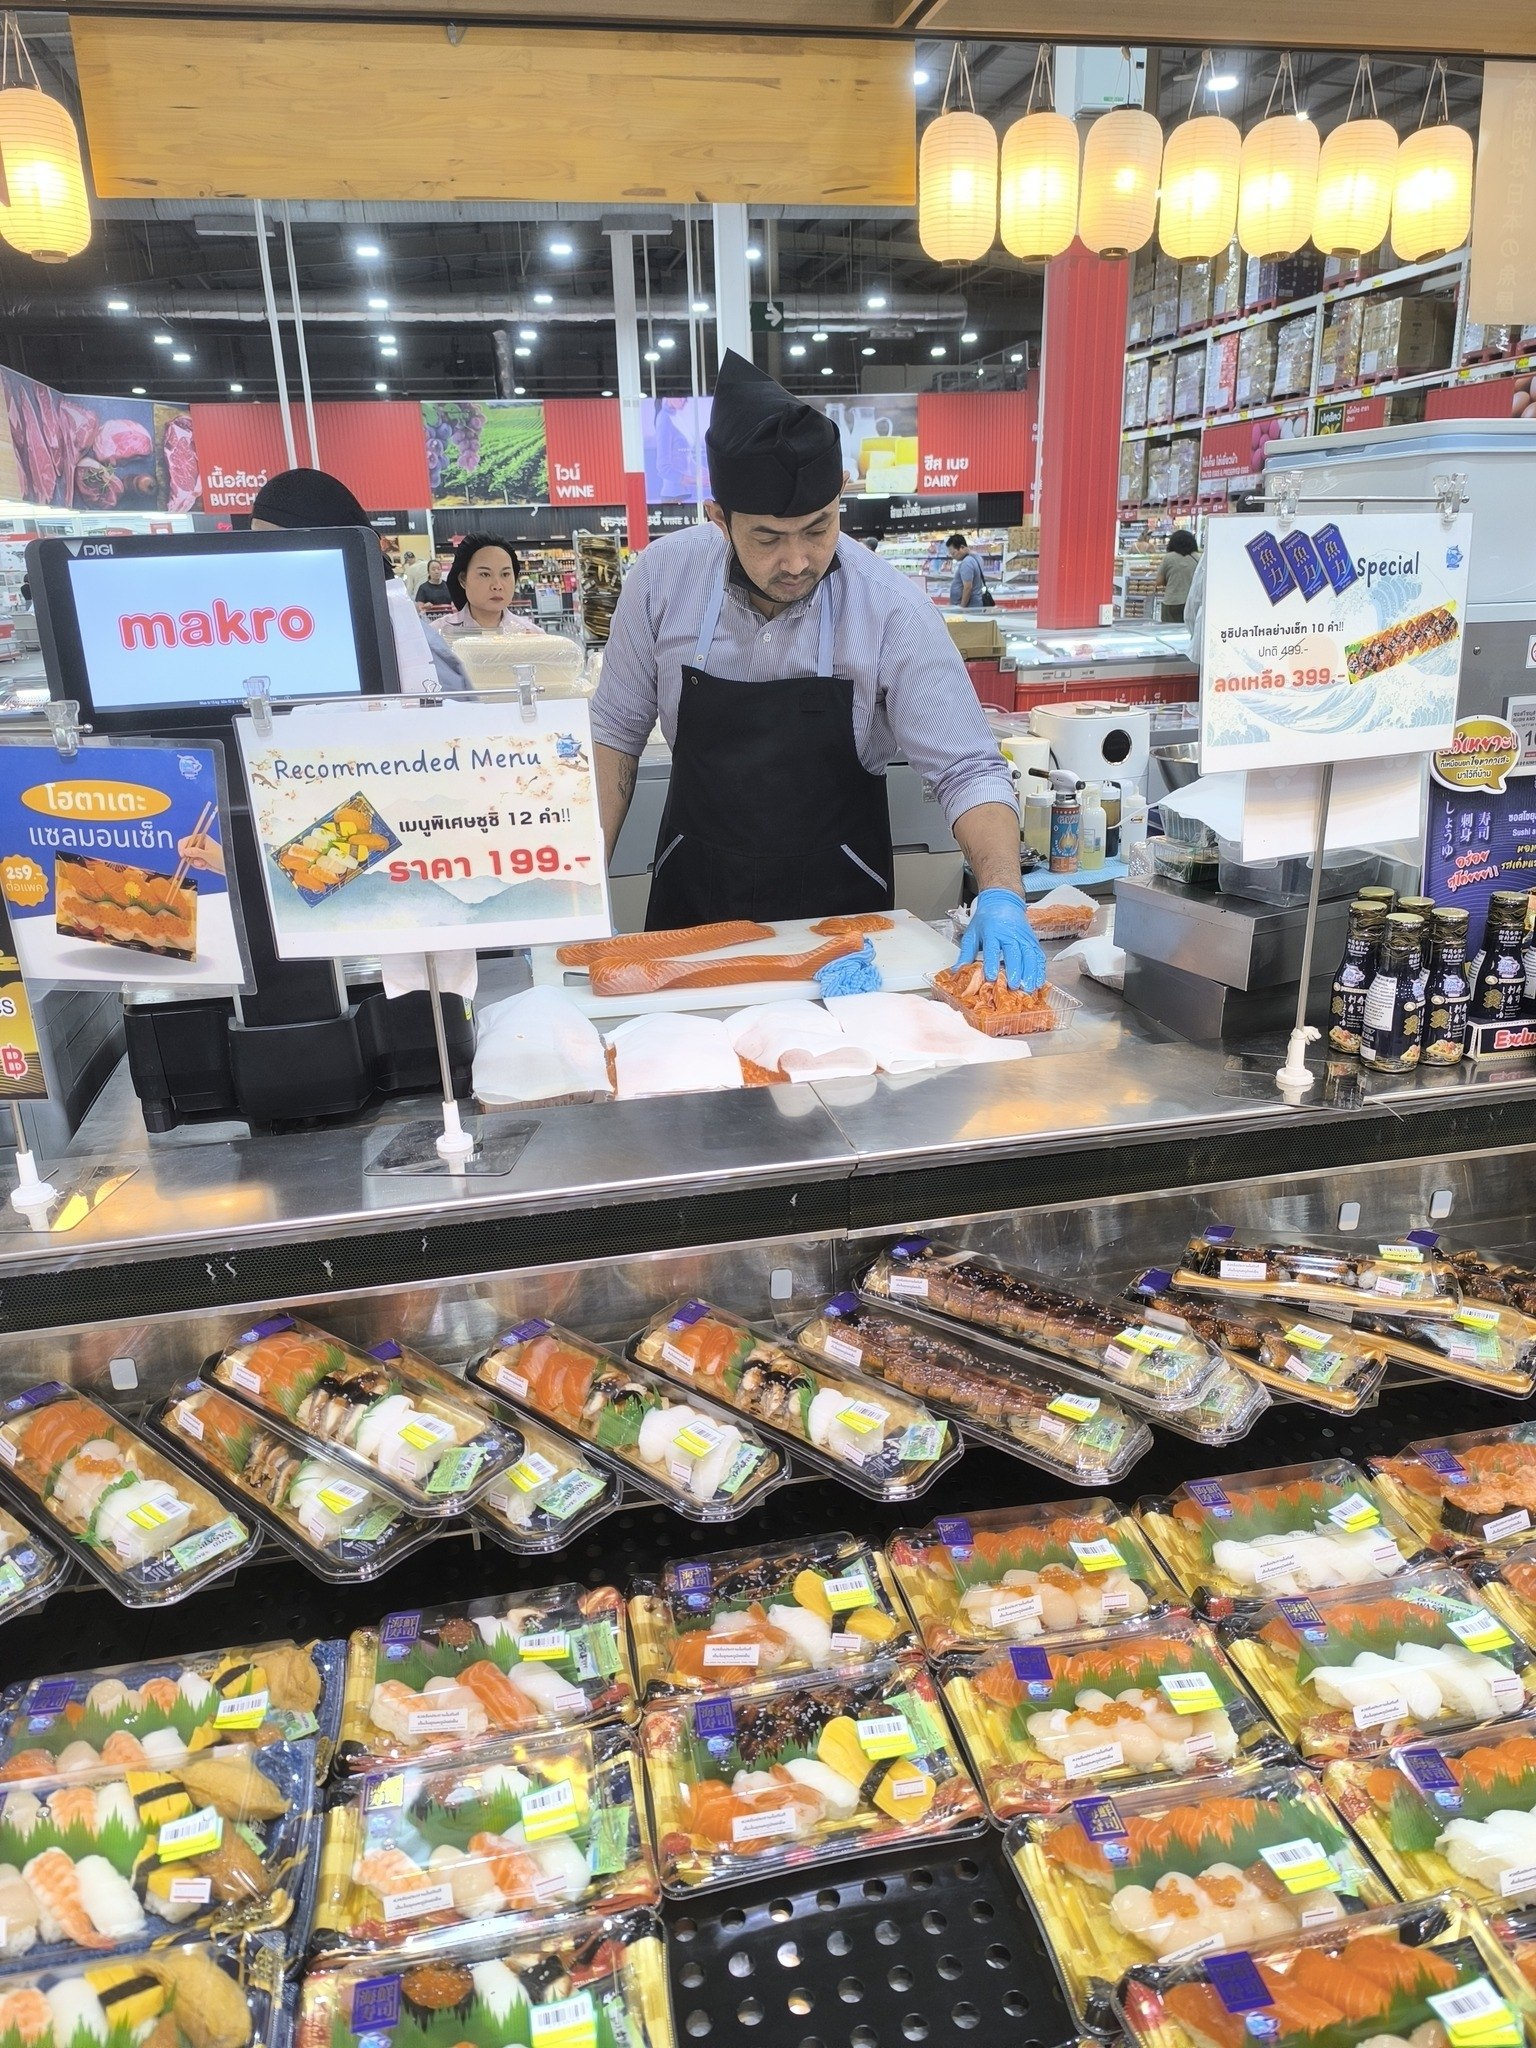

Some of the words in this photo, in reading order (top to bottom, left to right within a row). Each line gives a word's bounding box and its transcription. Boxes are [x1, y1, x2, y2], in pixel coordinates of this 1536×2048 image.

[554, 463, 581, 481] ไวน์
[924, 454, 942, 471] ชีส
[947, 457, 969, 471] เนย
[208, 466, 268, 488] เนื้อสัตว์
[923, 474, 959, 488] DAIRY
[556, 485, 595, 498] WINE
[83, 544, 114, 556] DIGI
[1325, 540, 1347, 580] 魚力
[1260, 548, 1285, 589] 魚力
[1293, 546, 1317, 587] 魚力
[1356, 551, 1420, 588] Special
[118, 597, 316, 651] makro
[1312, 623, 1325, 634] 10
[1327, 621, 1344, 633] คำ!!
[1258, 645, 1278, 658] ปกติ
[1214, 669, 1286, 694] ลดเหลือ
[1292, 668, 1346, 687] 399.-
[1438, 732, 1517, 756] ค่เหยาะ!
[274, 747, 460, 780] Recommended
[471, 748, 542, 769] Menu
[44, 783, 147, 813] โฮตาเตะ
[398, 810, 500, 836] เมนูพิเศษซูชิ
[508, 811, 533, 826] 12
[539, 807, 571, 824] คำ!!
[1441, 801, 1455, 858] しょうゆ
[1460, 813, 1473, 842] 刺身
[1478, 812, 1491, 840] 寿司
[1512, 828, 1530, 837] Sushi
[29, 821, 174, 849] แซลมอนเซ็ท
[388, 855, 472, 884] ราคา
[488, 845, 591, 876] 199.-
[1455, 850, 1490, 868] อร่อย
[5, 865, 43, 881] 259.-
[5, 879, 43, 895] ต่อแพค
